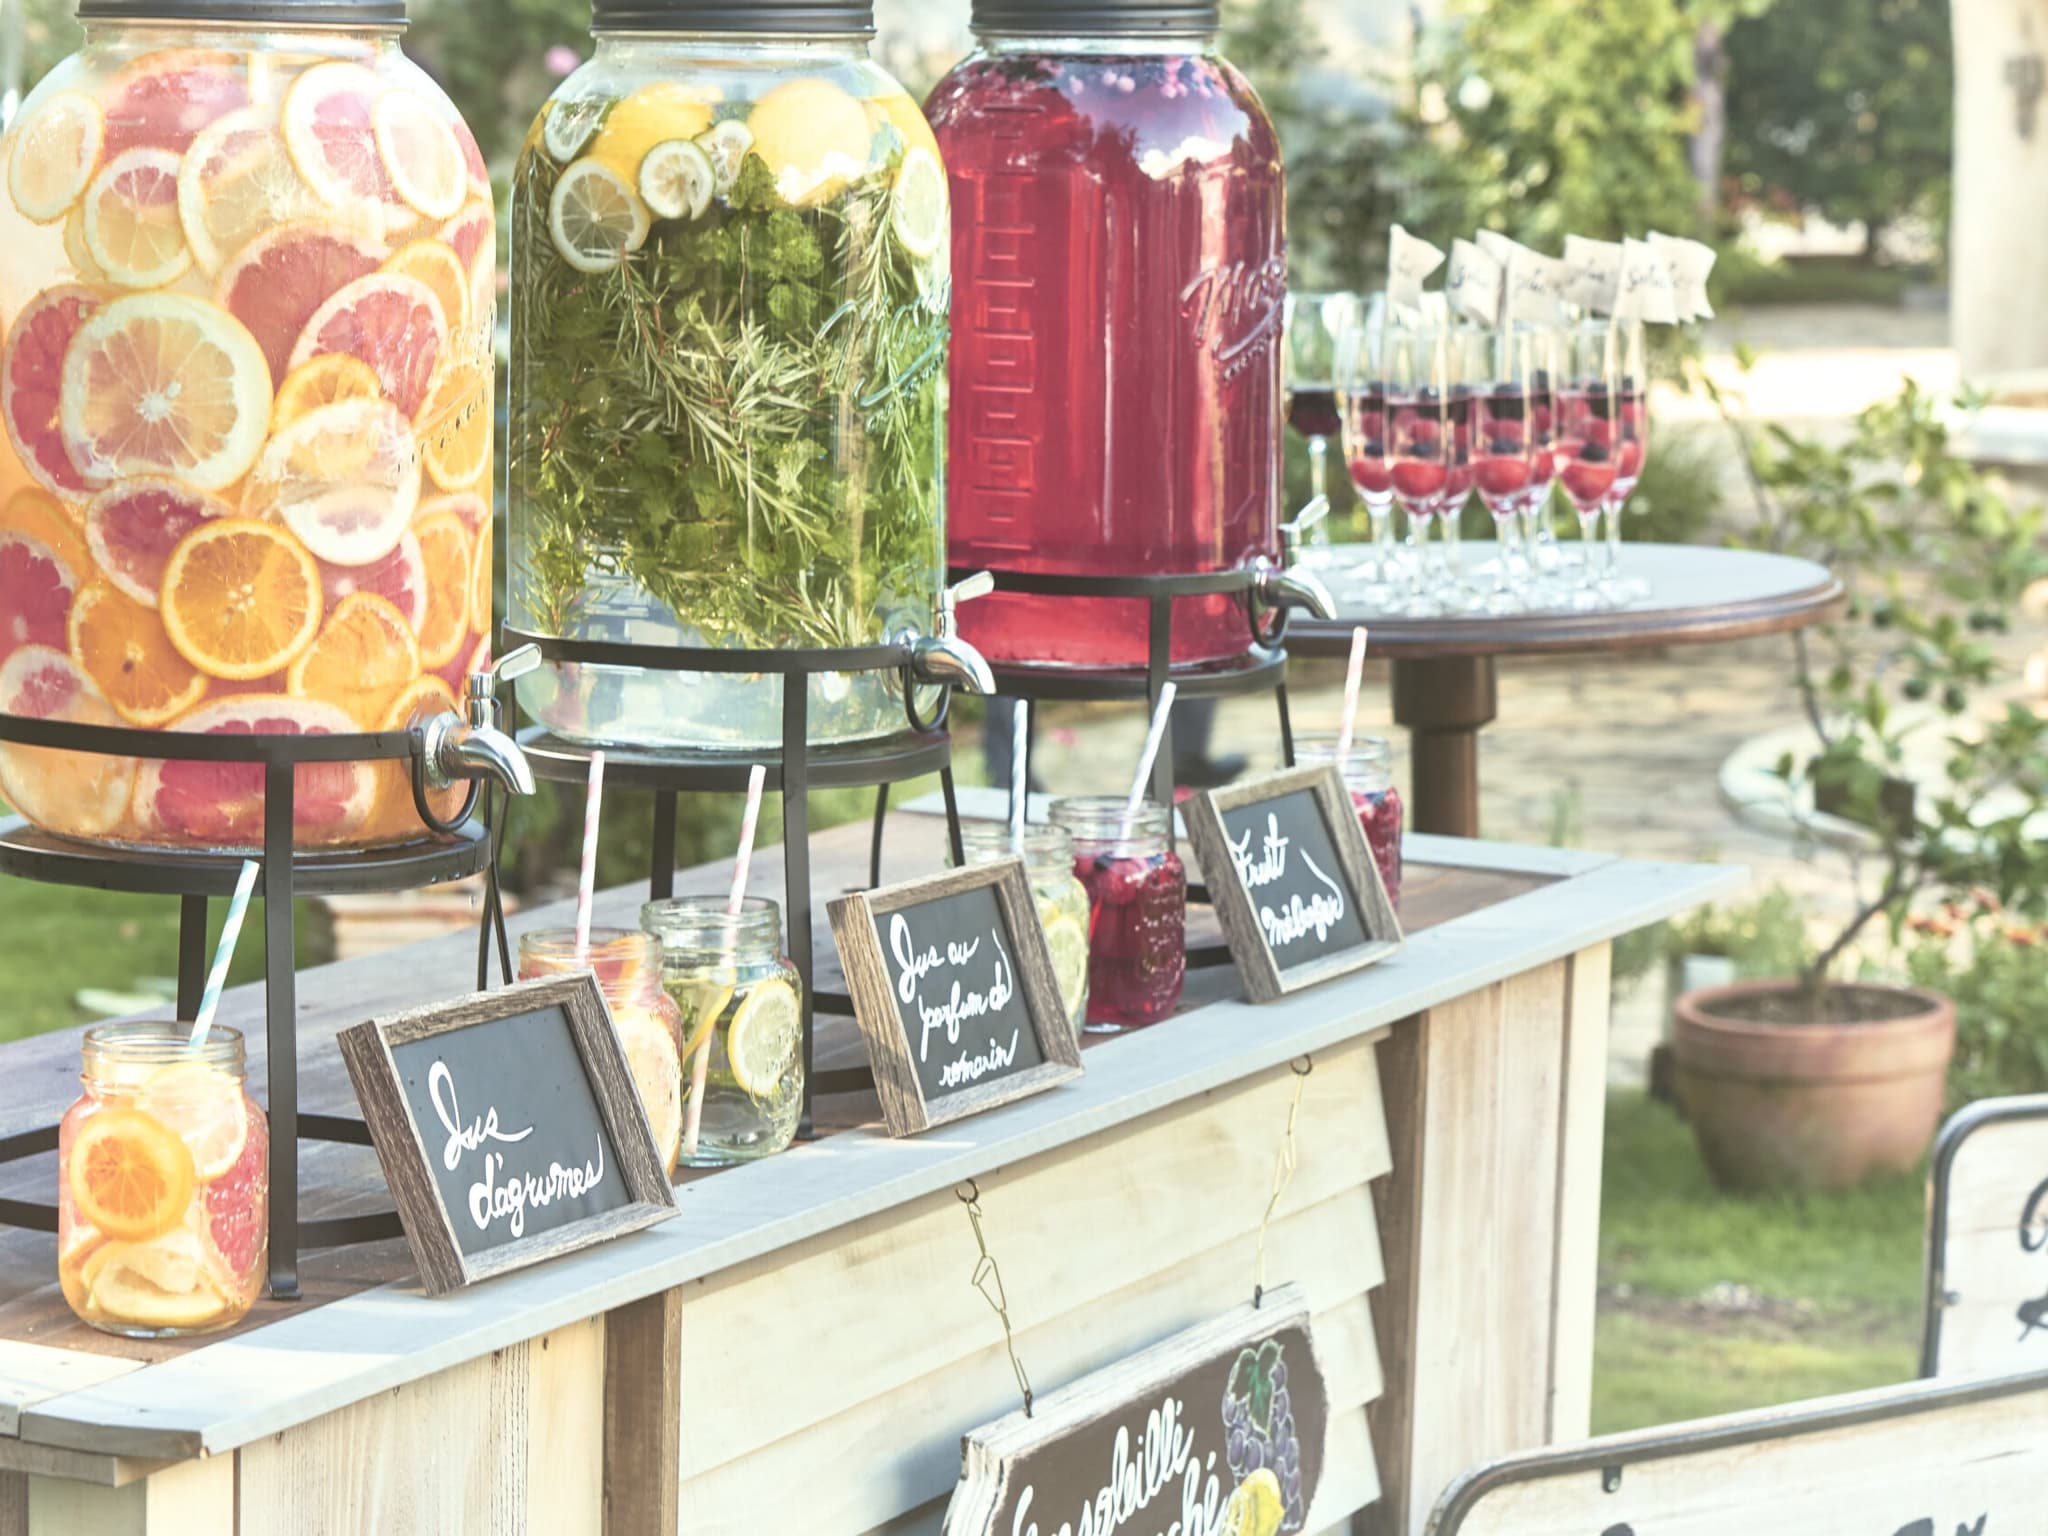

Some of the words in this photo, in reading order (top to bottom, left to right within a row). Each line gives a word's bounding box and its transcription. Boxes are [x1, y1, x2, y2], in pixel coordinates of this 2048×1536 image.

[889, 912, 945, 1004] Jus
[947, 935, 980, 967] au
[918, 980, 990, 1063] parfum
[938, 1028, 1019, 1087] romarin
[428, 1060, 534, 1171] Jus
[468, 1132, 605, 1239] d'agrumes
